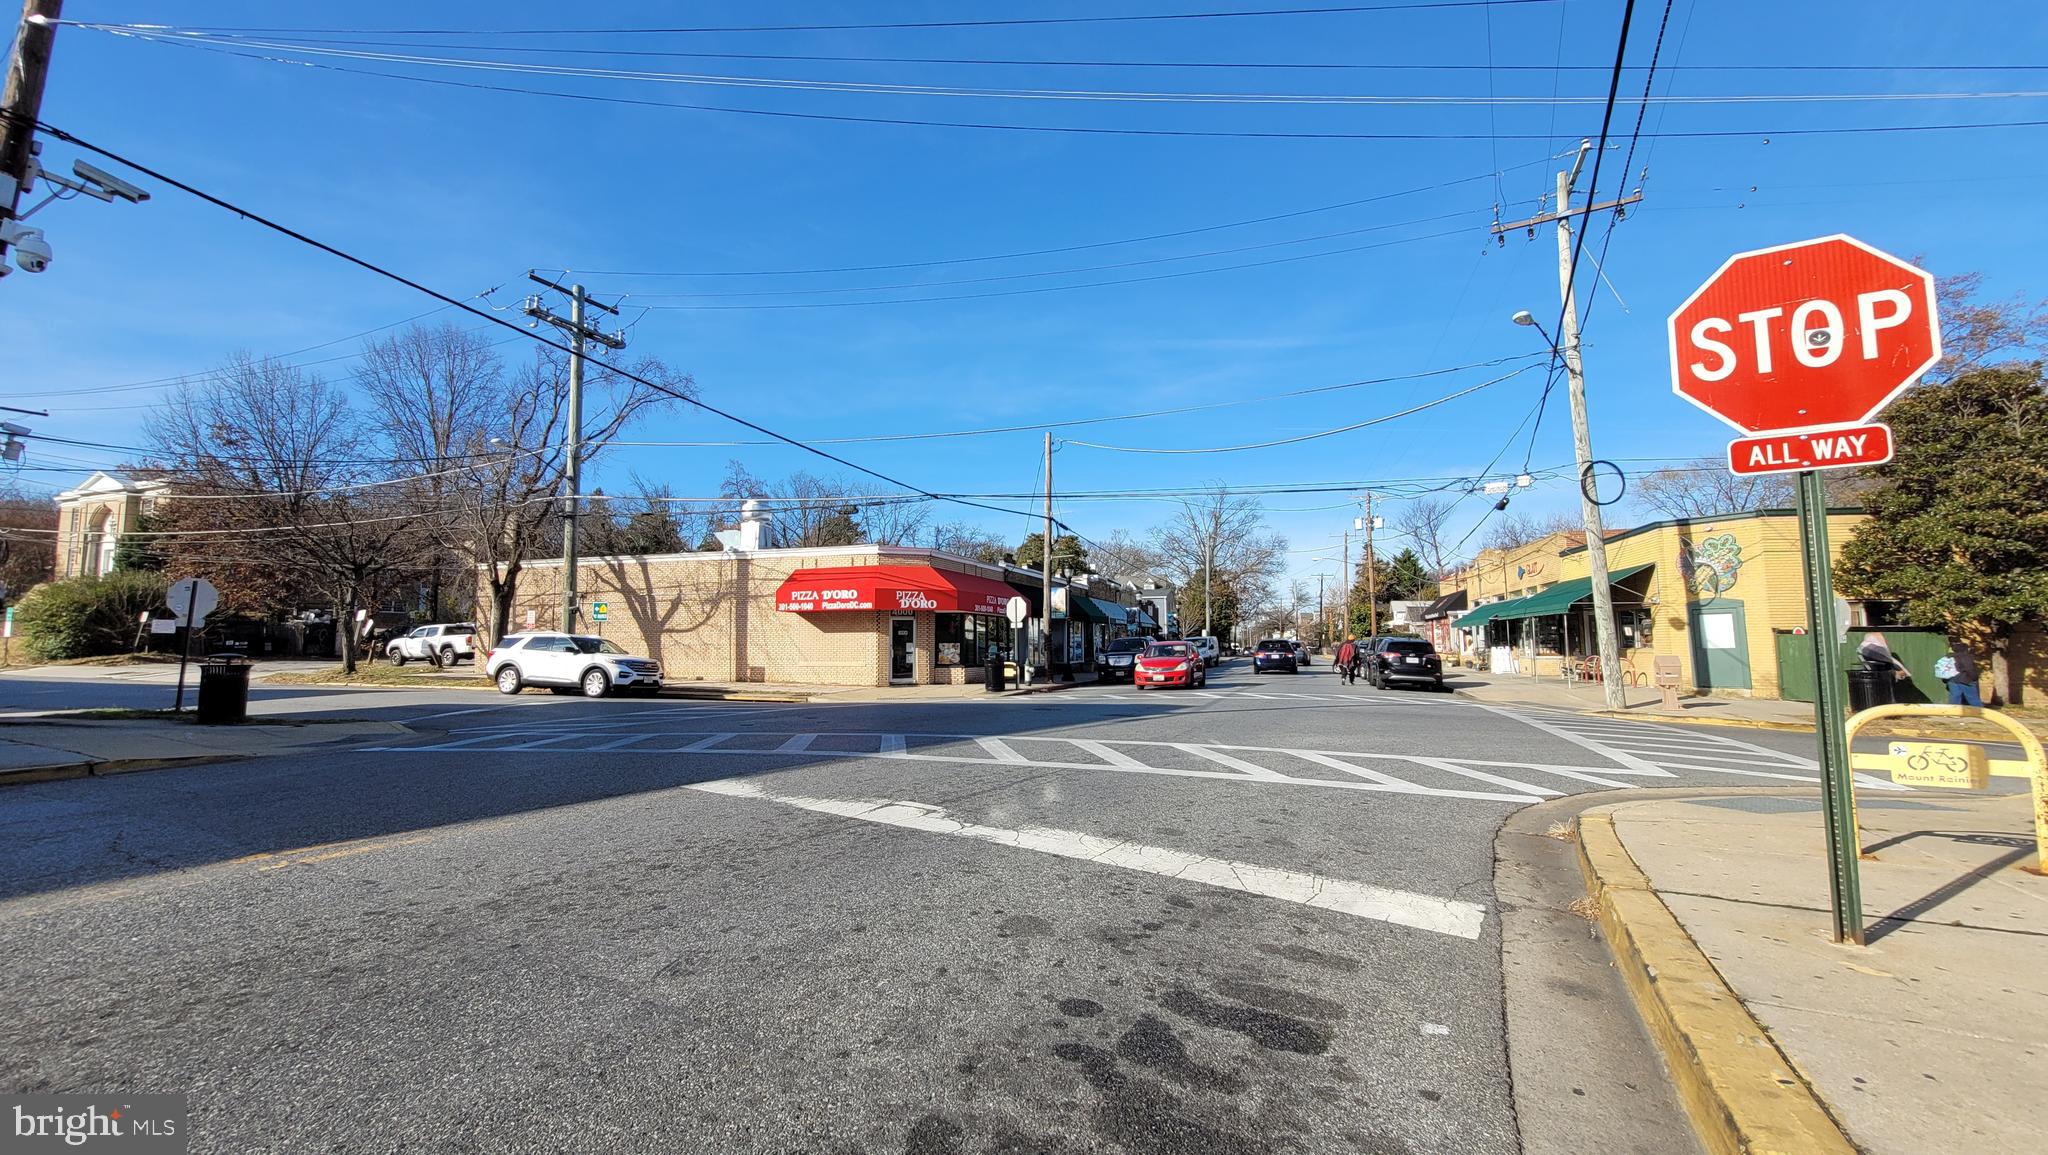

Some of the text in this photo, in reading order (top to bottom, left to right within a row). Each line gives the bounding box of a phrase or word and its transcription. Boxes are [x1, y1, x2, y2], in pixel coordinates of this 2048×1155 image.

[1690, 289, 1912, 382] STOP
[1749, 434, 1867, 466] ALL WAY
[791, 589, 858, 600] PIZZA D'ORO
[896, 591, 926, 600] PIZZA
[899, 599, 937, 609] D'ORO
[1897, 773, 1934, 782] Mount
